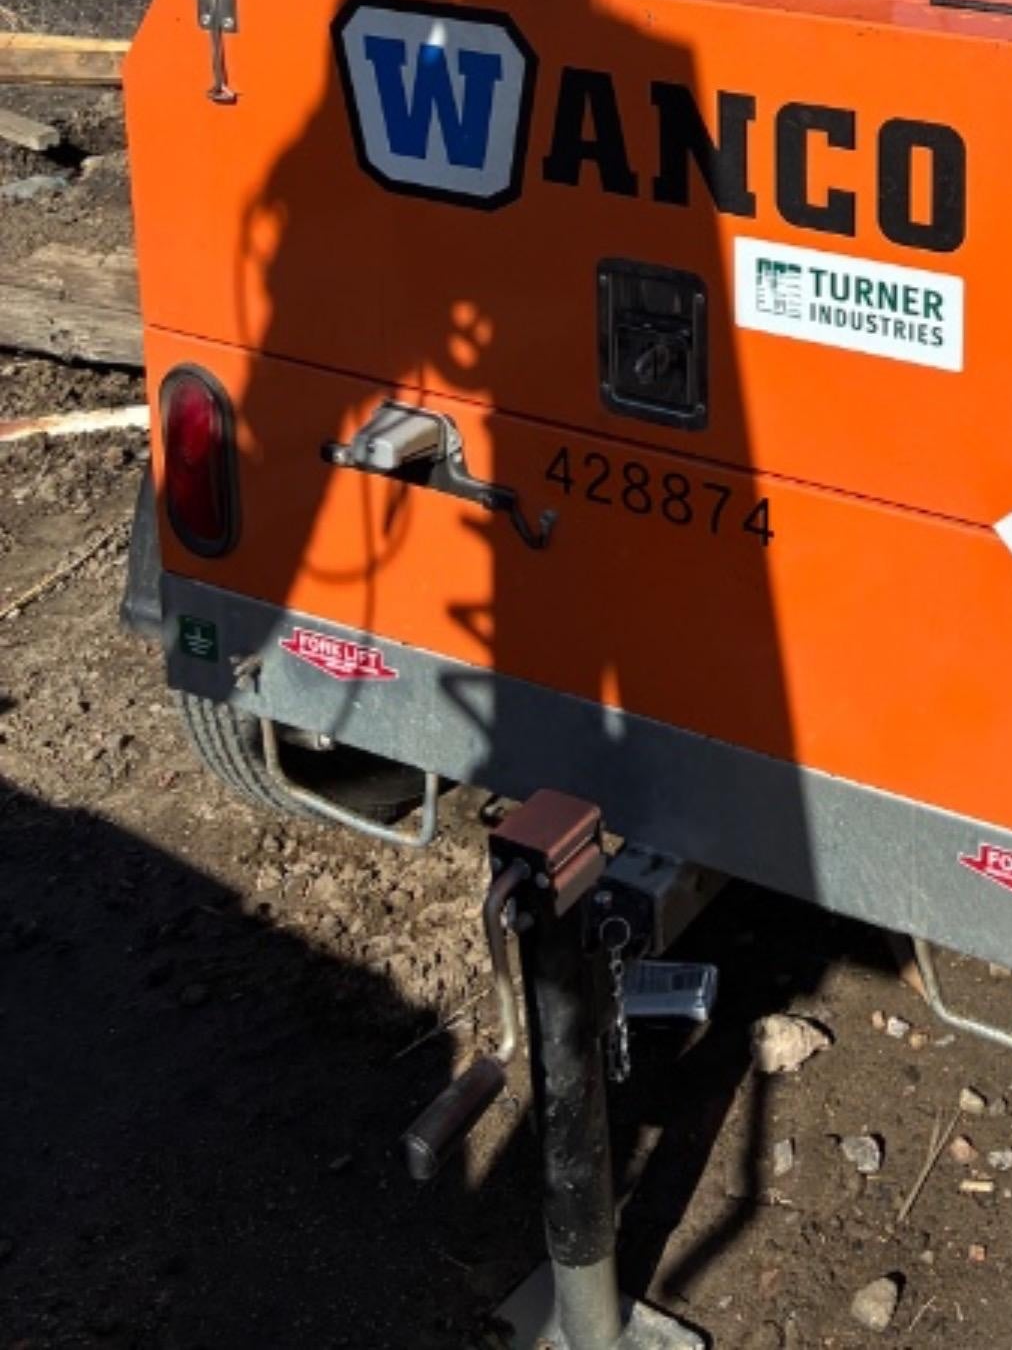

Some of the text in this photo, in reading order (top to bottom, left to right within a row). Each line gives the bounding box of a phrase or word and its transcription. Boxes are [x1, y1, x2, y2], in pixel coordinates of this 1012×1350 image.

[363, 34, 967, 253] WANCO
[809, 266, 944, 321] TURNER
[810, 302, 944, 347] INDUSTRIES
[545, 446, 775, 547] 428874
